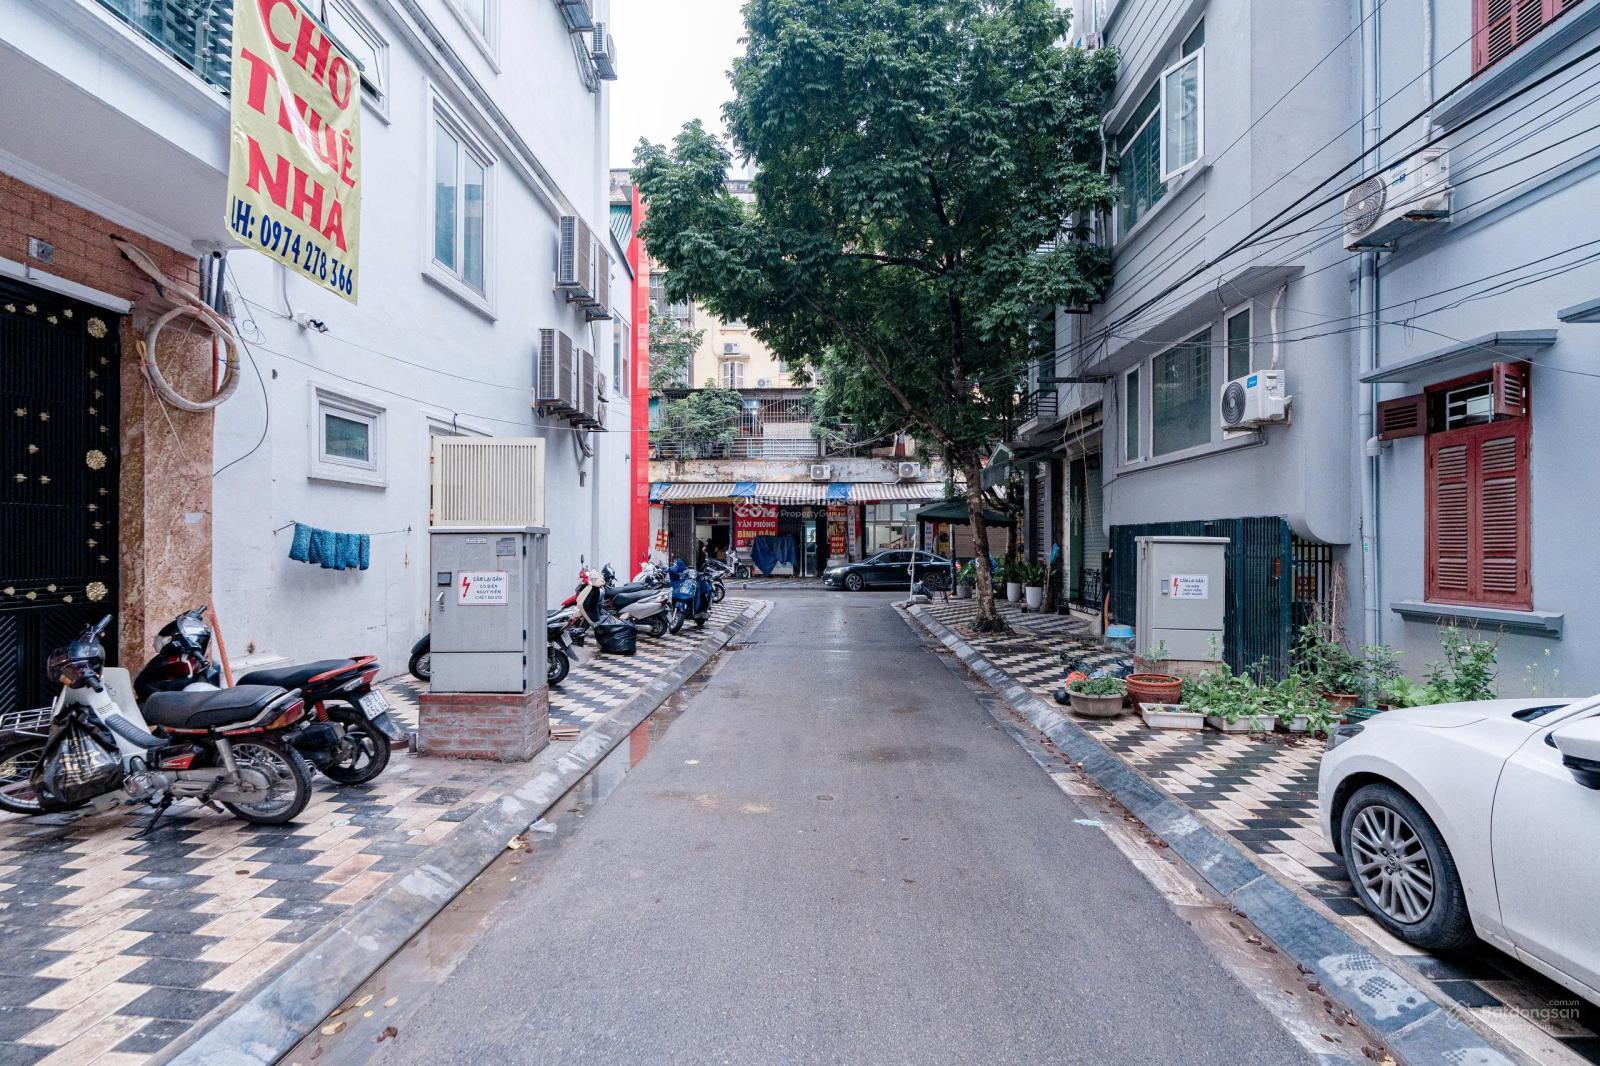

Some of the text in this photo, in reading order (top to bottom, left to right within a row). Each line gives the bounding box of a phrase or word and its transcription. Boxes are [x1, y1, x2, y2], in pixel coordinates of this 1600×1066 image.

[257, 0, 351, 110] CHO
[241, 48, 356, 188] THUÊ
[245, 136, 347, 252] NHÀ
[260, 214, 300, 264] 0974
[304, 237, 327, 281] 278
[330, 258, 353, 295] 366
[737, 529, 757, 539] BÌNH
[753, 520, 776, 528] PHÒNG
